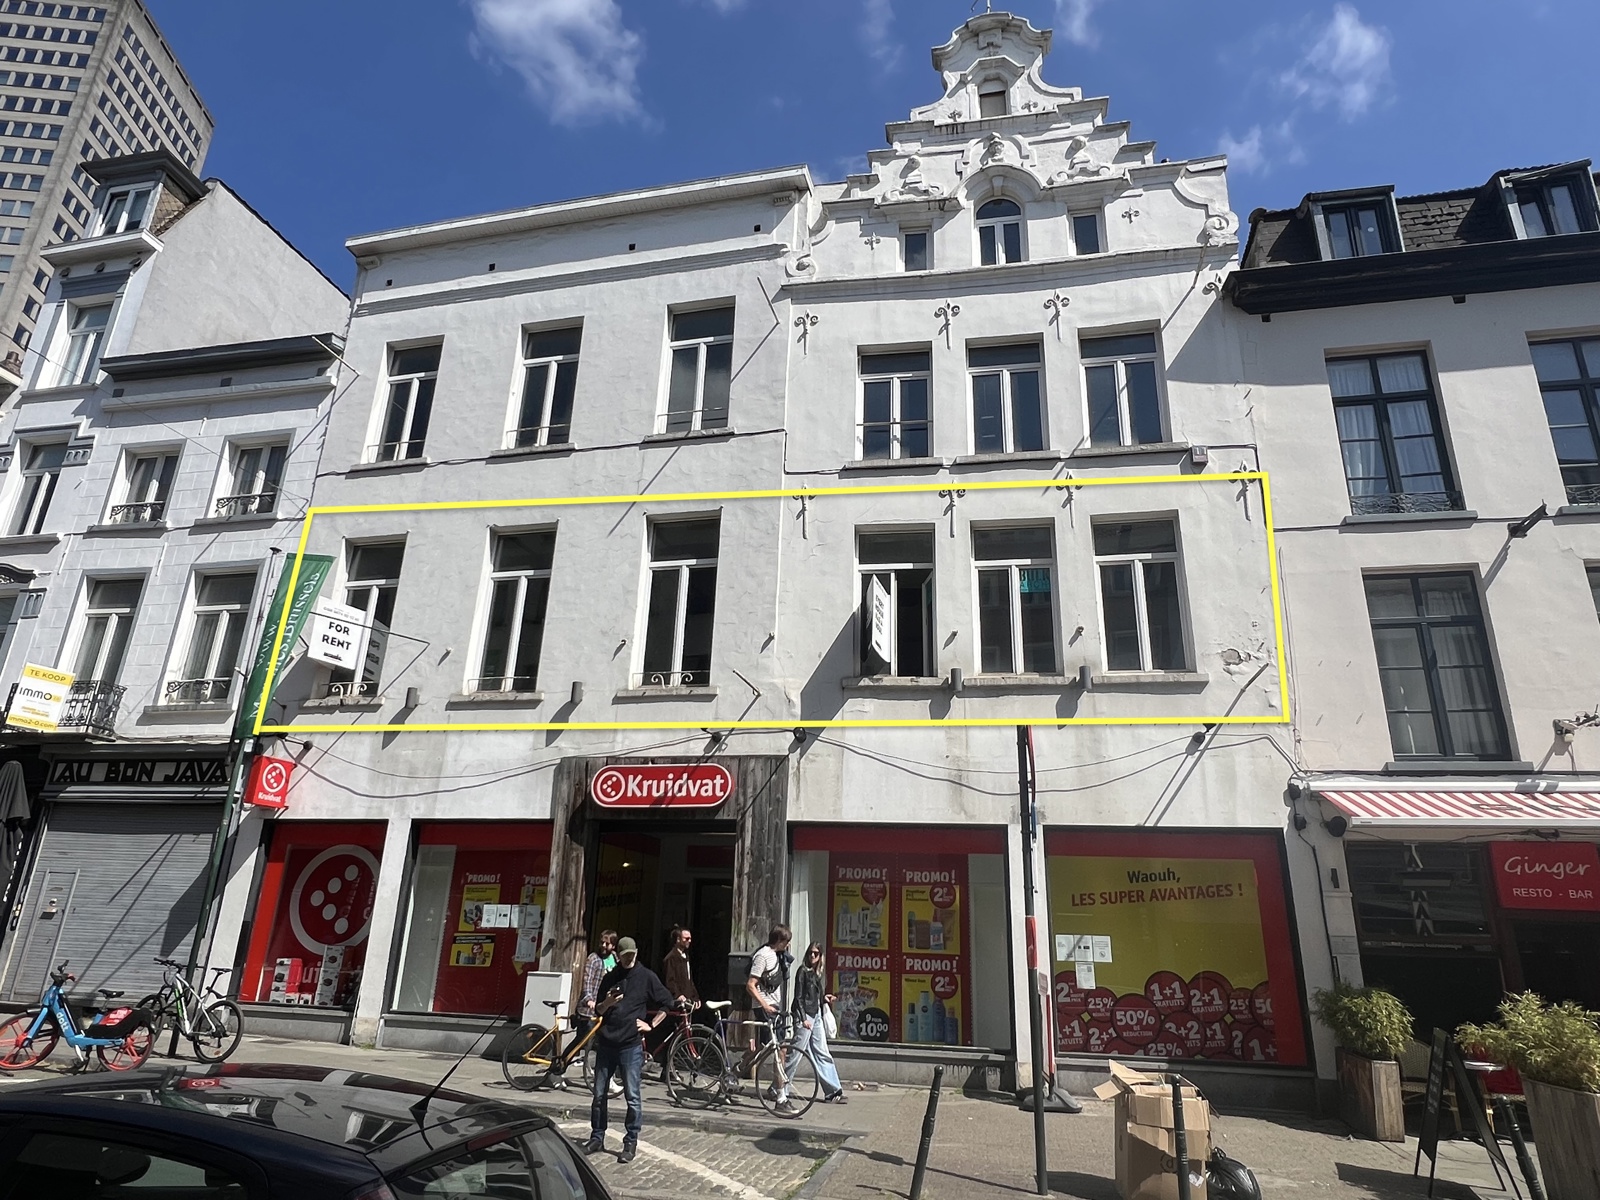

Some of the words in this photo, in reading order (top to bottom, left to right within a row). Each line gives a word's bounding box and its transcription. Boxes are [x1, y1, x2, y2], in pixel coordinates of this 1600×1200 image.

[328, 621, 350, 636] FOR
[321, 634, 352, 651] RENT
[30, 669, 40, 677] TE
[42, 672, 66, 682] KOOP
[54, 761, 91, 782] AU
[104, 761, 155, 782] BON
[626, 773, 725, 798] Kruidvat
[258, 792, 282, 803] Kruidvat
[1127, 868, 1181, 884] Waouh,
[1504, 856, 1591, 880] Ginger
[1071, 892, 1096, 907] LES
[1099, 889, 1145, 905] SUPER
[1149, 883, 1234, 902] AVANTAGES
[1512, 888, 1553, 898] RESTO
[1568, 889, 1593, 899] BAR
[1150, 981, 1184, 1000] 1+1
[1189, 988, 1222, 1006] 2+1
[1230, 999, 1249, 1010] 25
[56, 1012, 69, 1033] dott
[1116, 1010, 1156, 1026] 50%
[1206, 1022, 1225, 1040] +1
[1147, 1043, 1183, 1057] 25%
